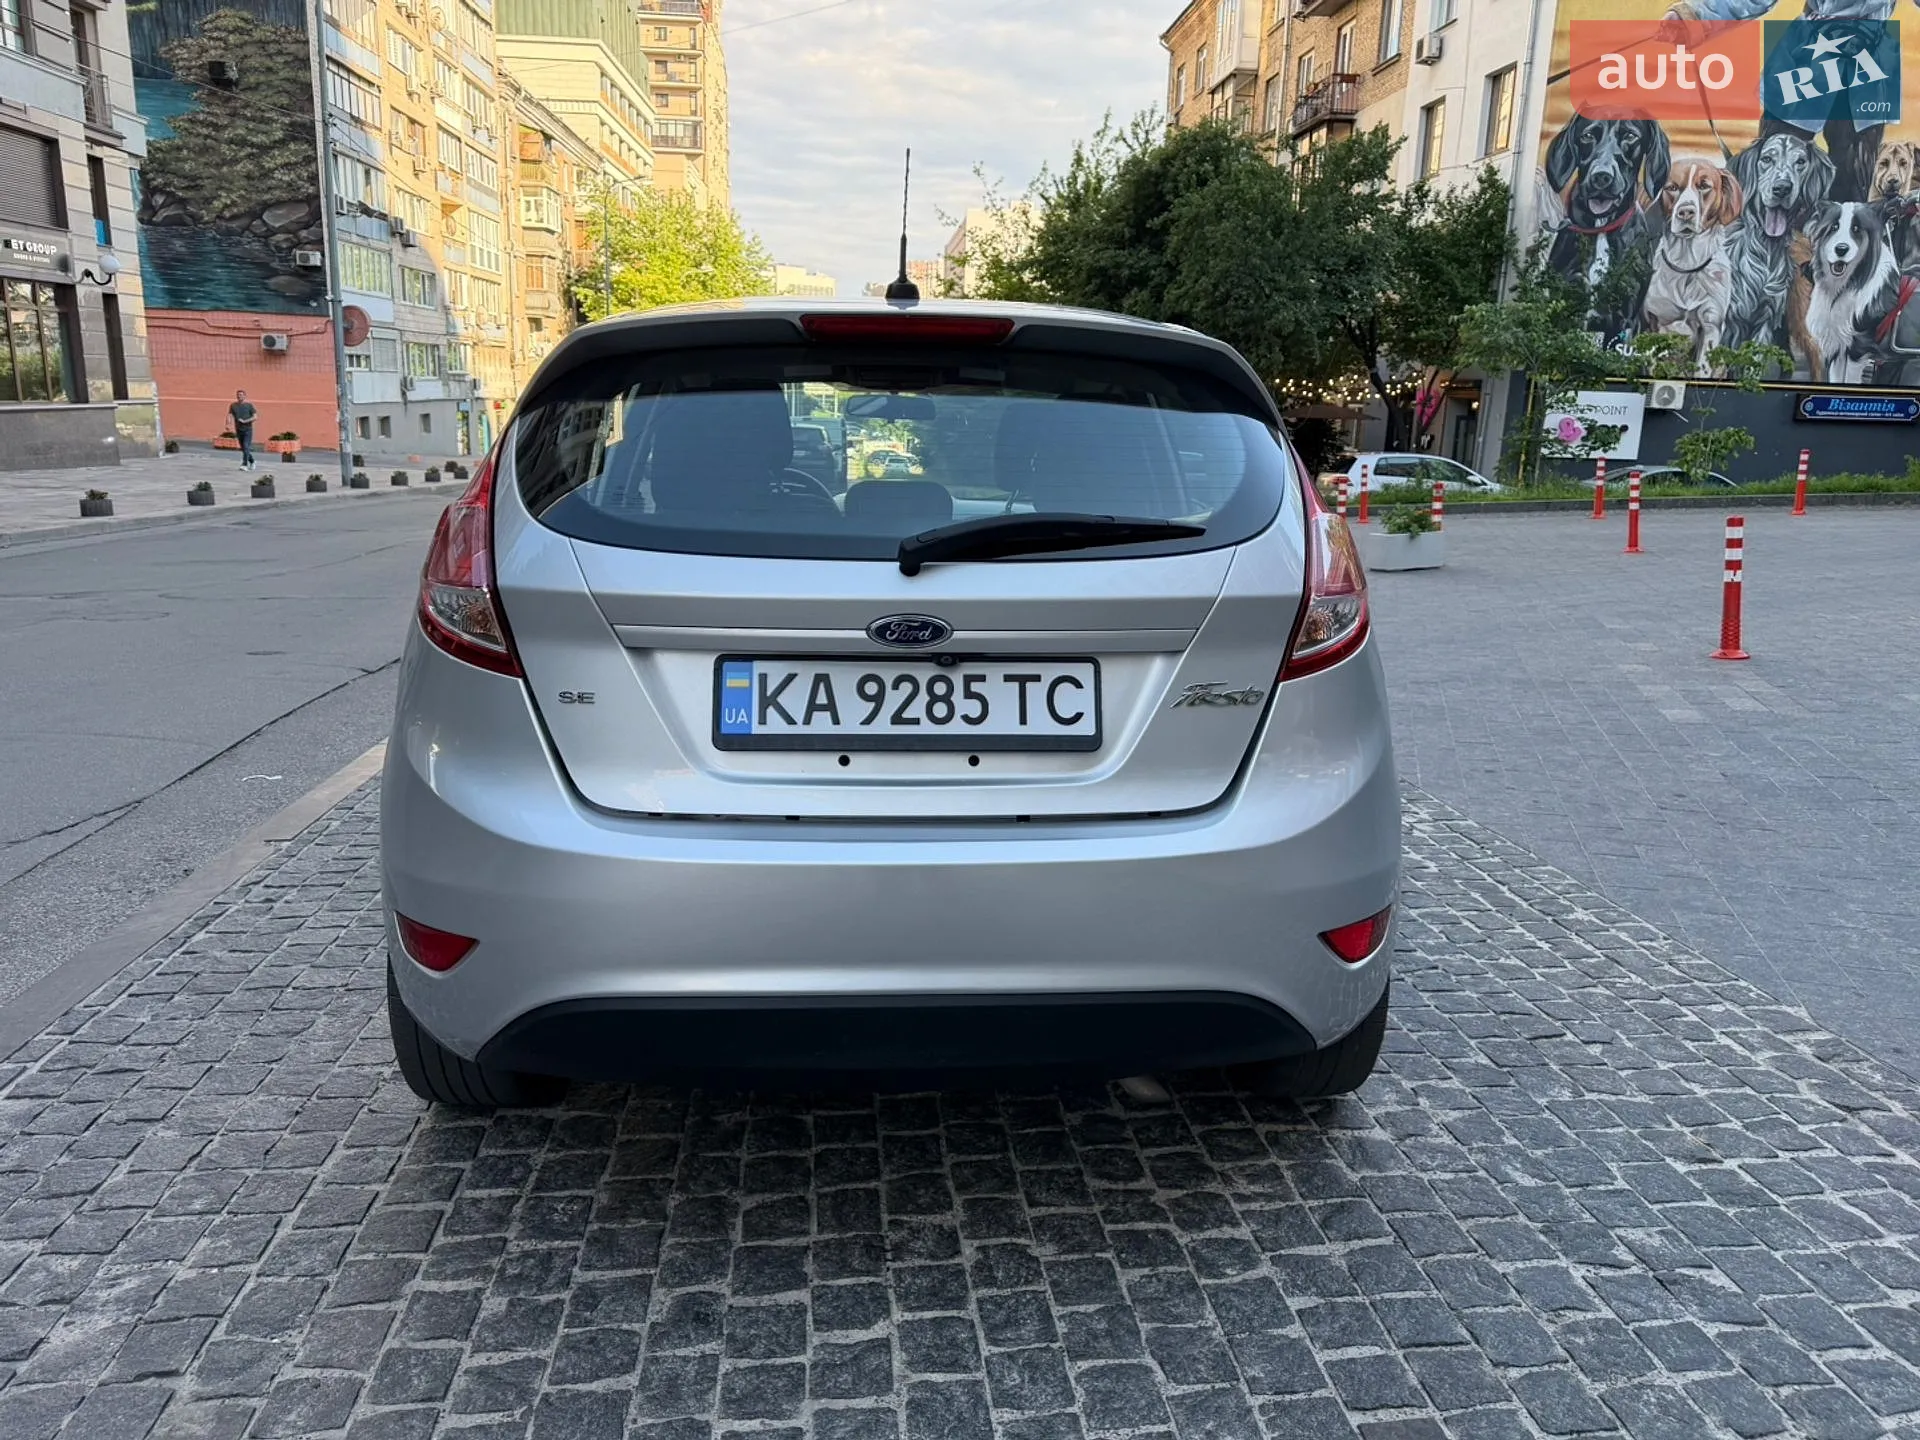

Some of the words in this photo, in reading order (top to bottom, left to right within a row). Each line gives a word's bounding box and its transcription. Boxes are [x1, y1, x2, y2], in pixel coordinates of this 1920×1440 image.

[1828, 398, 1895, 411] Візантія
[886, 621, 933, 640] Ford
[558, 690, 596, 704] SE
[757, 673, 841, 726] KA
[856, 674, 989, 726] 9285
[1003, 675, 1085, 726] TC
[725, 708, 748, 724] UA
